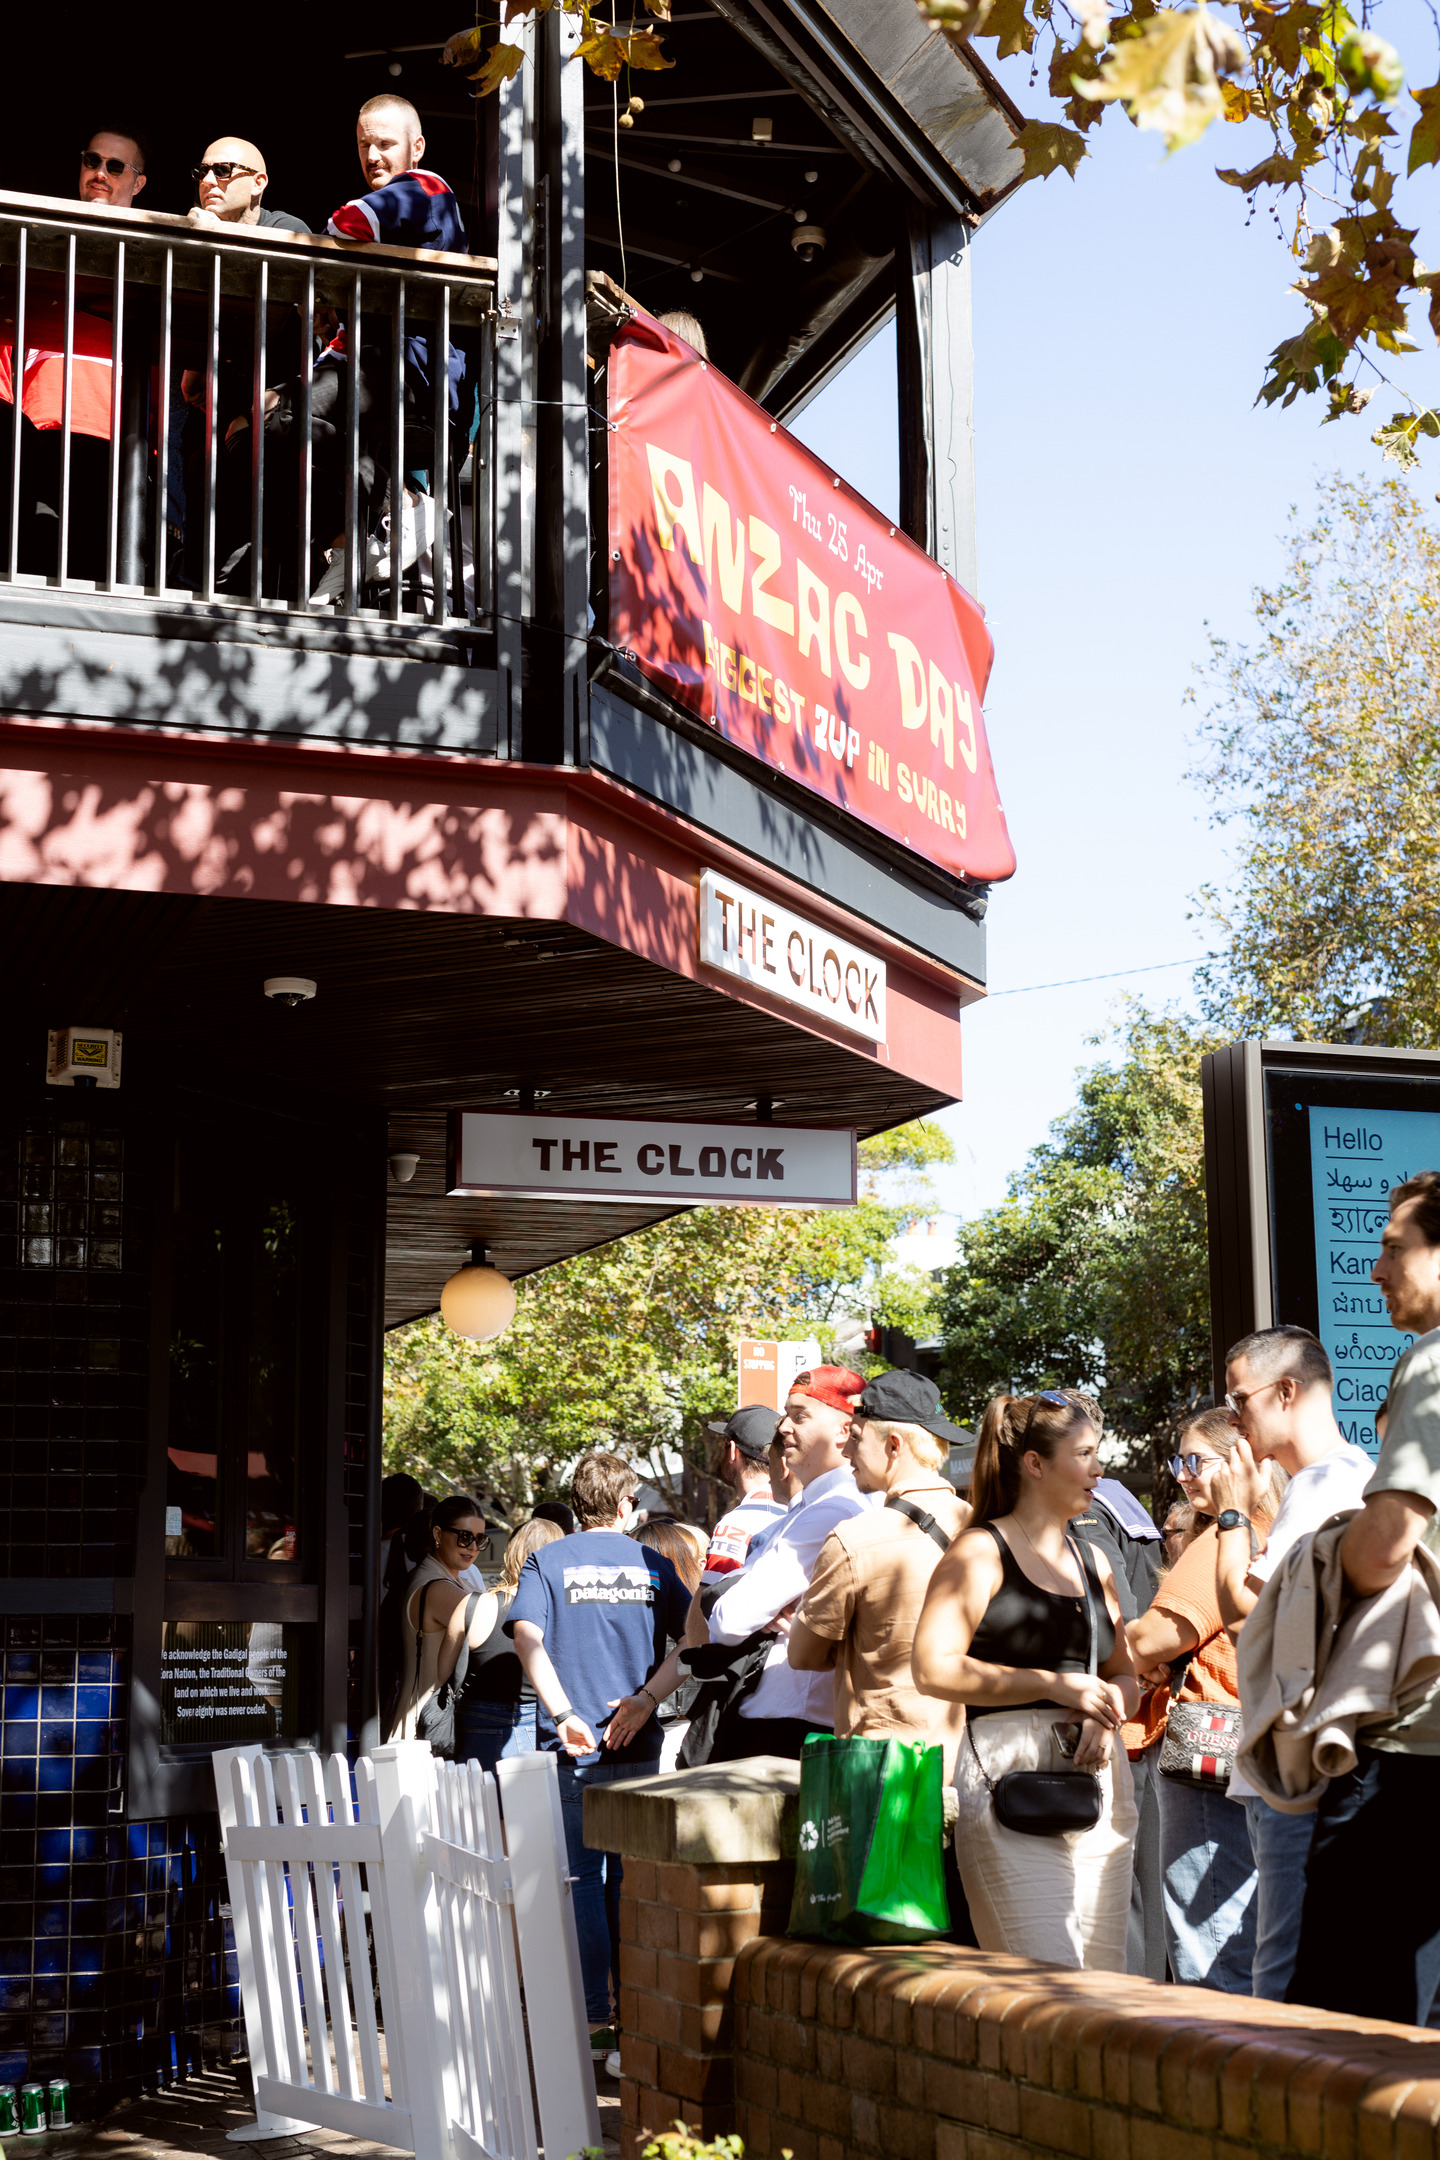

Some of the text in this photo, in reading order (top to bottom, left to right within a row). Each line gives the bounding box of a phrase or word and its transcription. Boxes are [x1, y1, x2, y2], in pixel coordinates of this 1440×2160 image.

[788, 485, 883, 591] Thu 25 Apr
[646, 442, 977, 775] ANZAC DAY
[813, 708, 860, 769] 2UP
[896, 762, 967, 840] SURRY
[715, 889, 879, 1025] THE CLOCK
[1324, 1126, 1383, 1151] Hello
[532, 1137, 784, 1181] THE CLOCK
[1330, 1251, 1379, 1275] Kam
[753, 1346, 765, 1357] NO
[743, 1359, 775, 1371] STOPPING
[1336, 1378, 1389, 1402] Ciao
[570, 1585, 655, 1604] patagonia
[168, 1648, 211, 1662] acknowledge
[212, 1648, 222, 1660] the
[224, 1648, 248, 1662] Gadigal
[270, 1648, 277, 1659] of
[277, 1648, 288, 1659] the
[161, 1667, 286, 1680] ora Nation, the Traditional Owners of the
[174, 1686, 189, 1698] land
[190, 1688, 198, 1698] on
[199, 1686, 218, 1697] which
[219, 1688, 228, 1697] we
[229, 1685, 240, 1696] live
[241, 1685, 253, 1696] and
[177, 1703, 267, 1719] Sovereignty was never ceded.
[1187, 1729, 1240, 1750] GUESS
